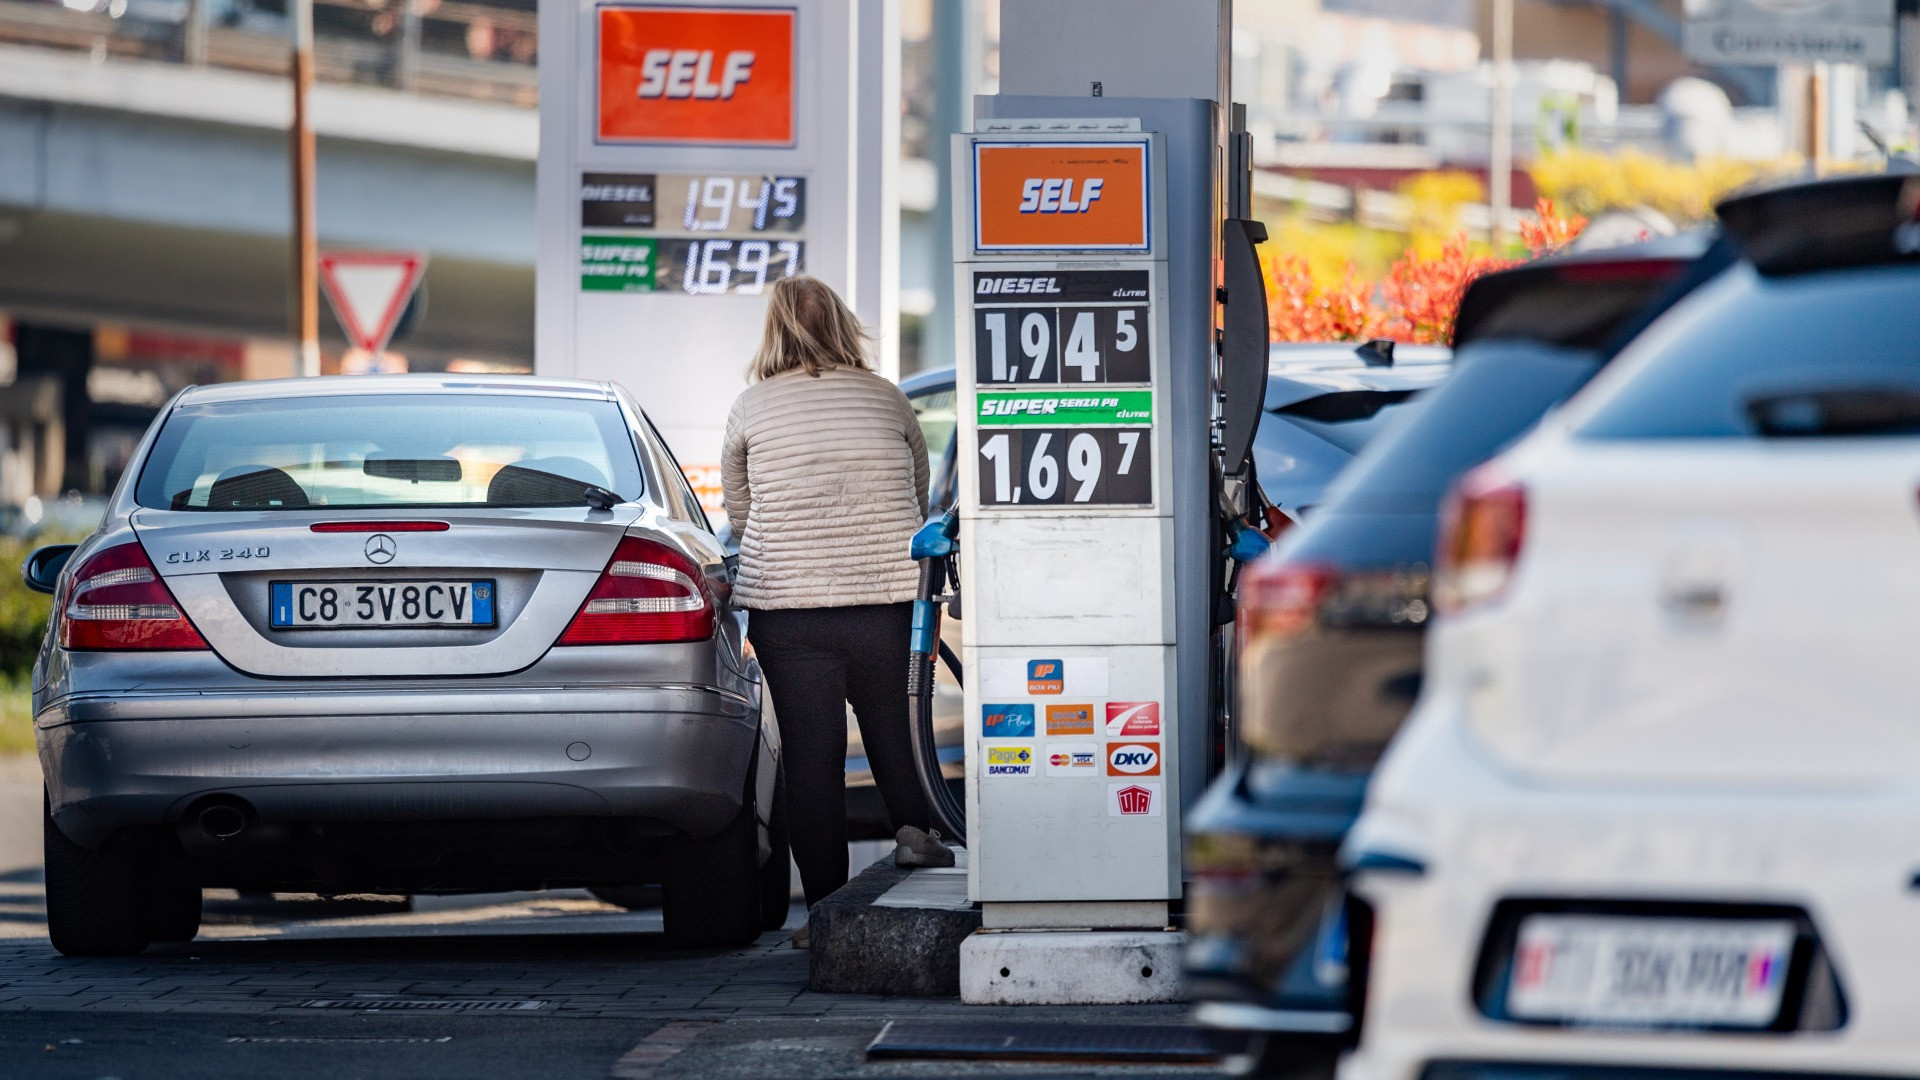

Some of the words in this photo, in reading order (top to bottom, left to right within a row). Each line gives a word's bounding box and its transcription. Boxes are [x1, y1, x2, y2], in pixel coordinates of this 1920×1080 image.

[638, 50, 755, 99] SELF
[582, 184, 651, 202] DIESEL
[1019, 178, 1104, 214] SELF
[582, 244, 650, 262] SUPER
[976, 277, 1061, 294] DIESEL
[980, 398, 1059, 417] SUPER
[1059, 398, 1098, 408] SENZA
[1101, 398, 1119, 407] PB
[166, 549, 210, 563] CLK
[219, 546, 270, 560] 240
[1005, 714, 1031, 727] Plus
[989, 748, 1017, 763] Pago
[1114, 753, 1153, 765] DKV
[989, 766, 1030, 775] BANCOMAT
[1118, 786, 1151, 813] UTA
